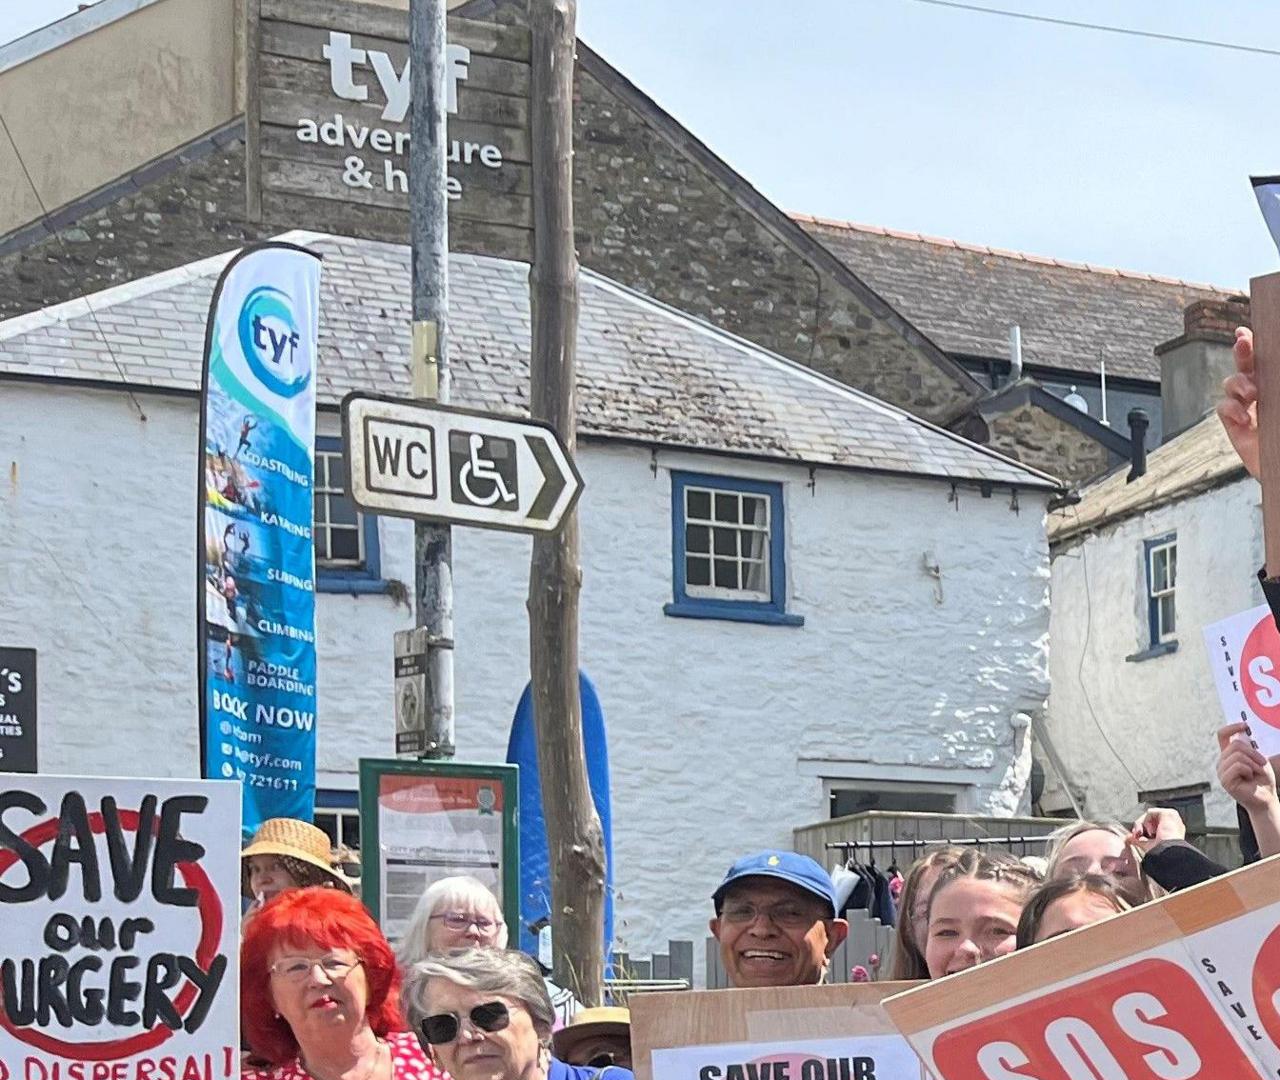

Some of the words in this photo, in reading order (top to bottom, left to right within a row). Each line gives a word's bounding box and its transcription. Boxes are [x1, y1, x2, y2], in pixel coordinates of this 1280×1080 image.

[323, 31, 470, 122] tyf
[296, 113, 503, 169] advenure
[342, 155, 373, 190] &
[384, 159, 463, 200] he
[252, 313, 300, 364] tyf
[372, 434, 429, 480] WC
[248, 661, 299, 679] PADDLE
[1220, 636, 1239, 692] SAVE
[255, 703, 314, 732] NOW
[0, 790, 208, 907] SAVE
[1201, 957, 1261, 1040] SAVE
